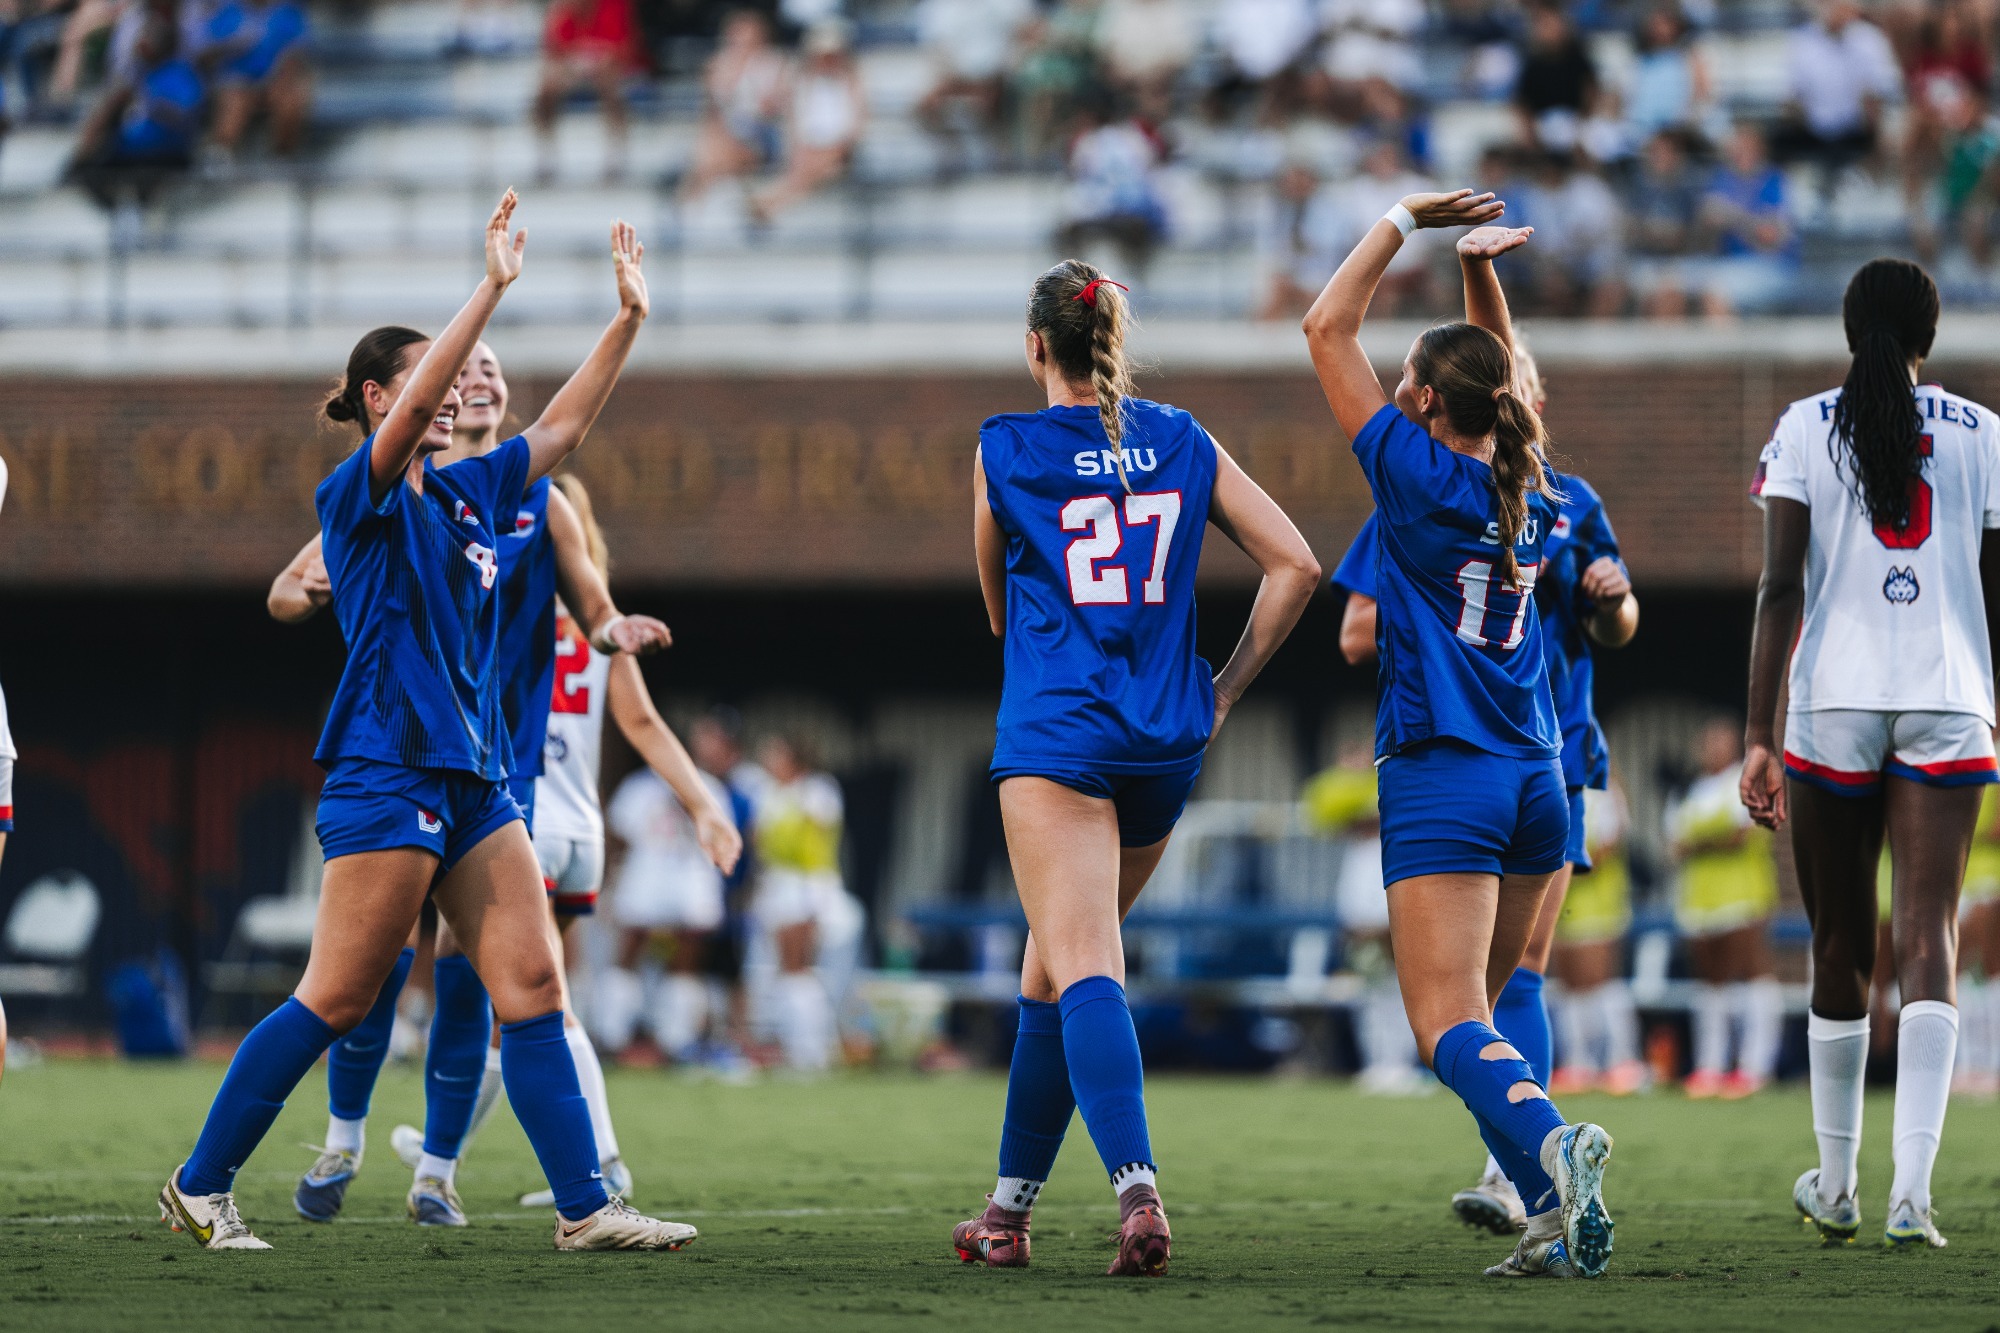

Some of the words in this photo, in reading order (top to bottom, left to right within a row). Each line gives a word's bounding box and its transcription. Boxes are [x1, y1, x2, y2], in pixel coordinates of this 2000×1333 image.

[1819, 397, 1981, 431] HIES
[1073, 448, 1158, 476] SMU
[1058, 489, 1182, 606] 27
[1479, 519, 1538, 546] SU
[1454, 557, 1538, 648] 17
